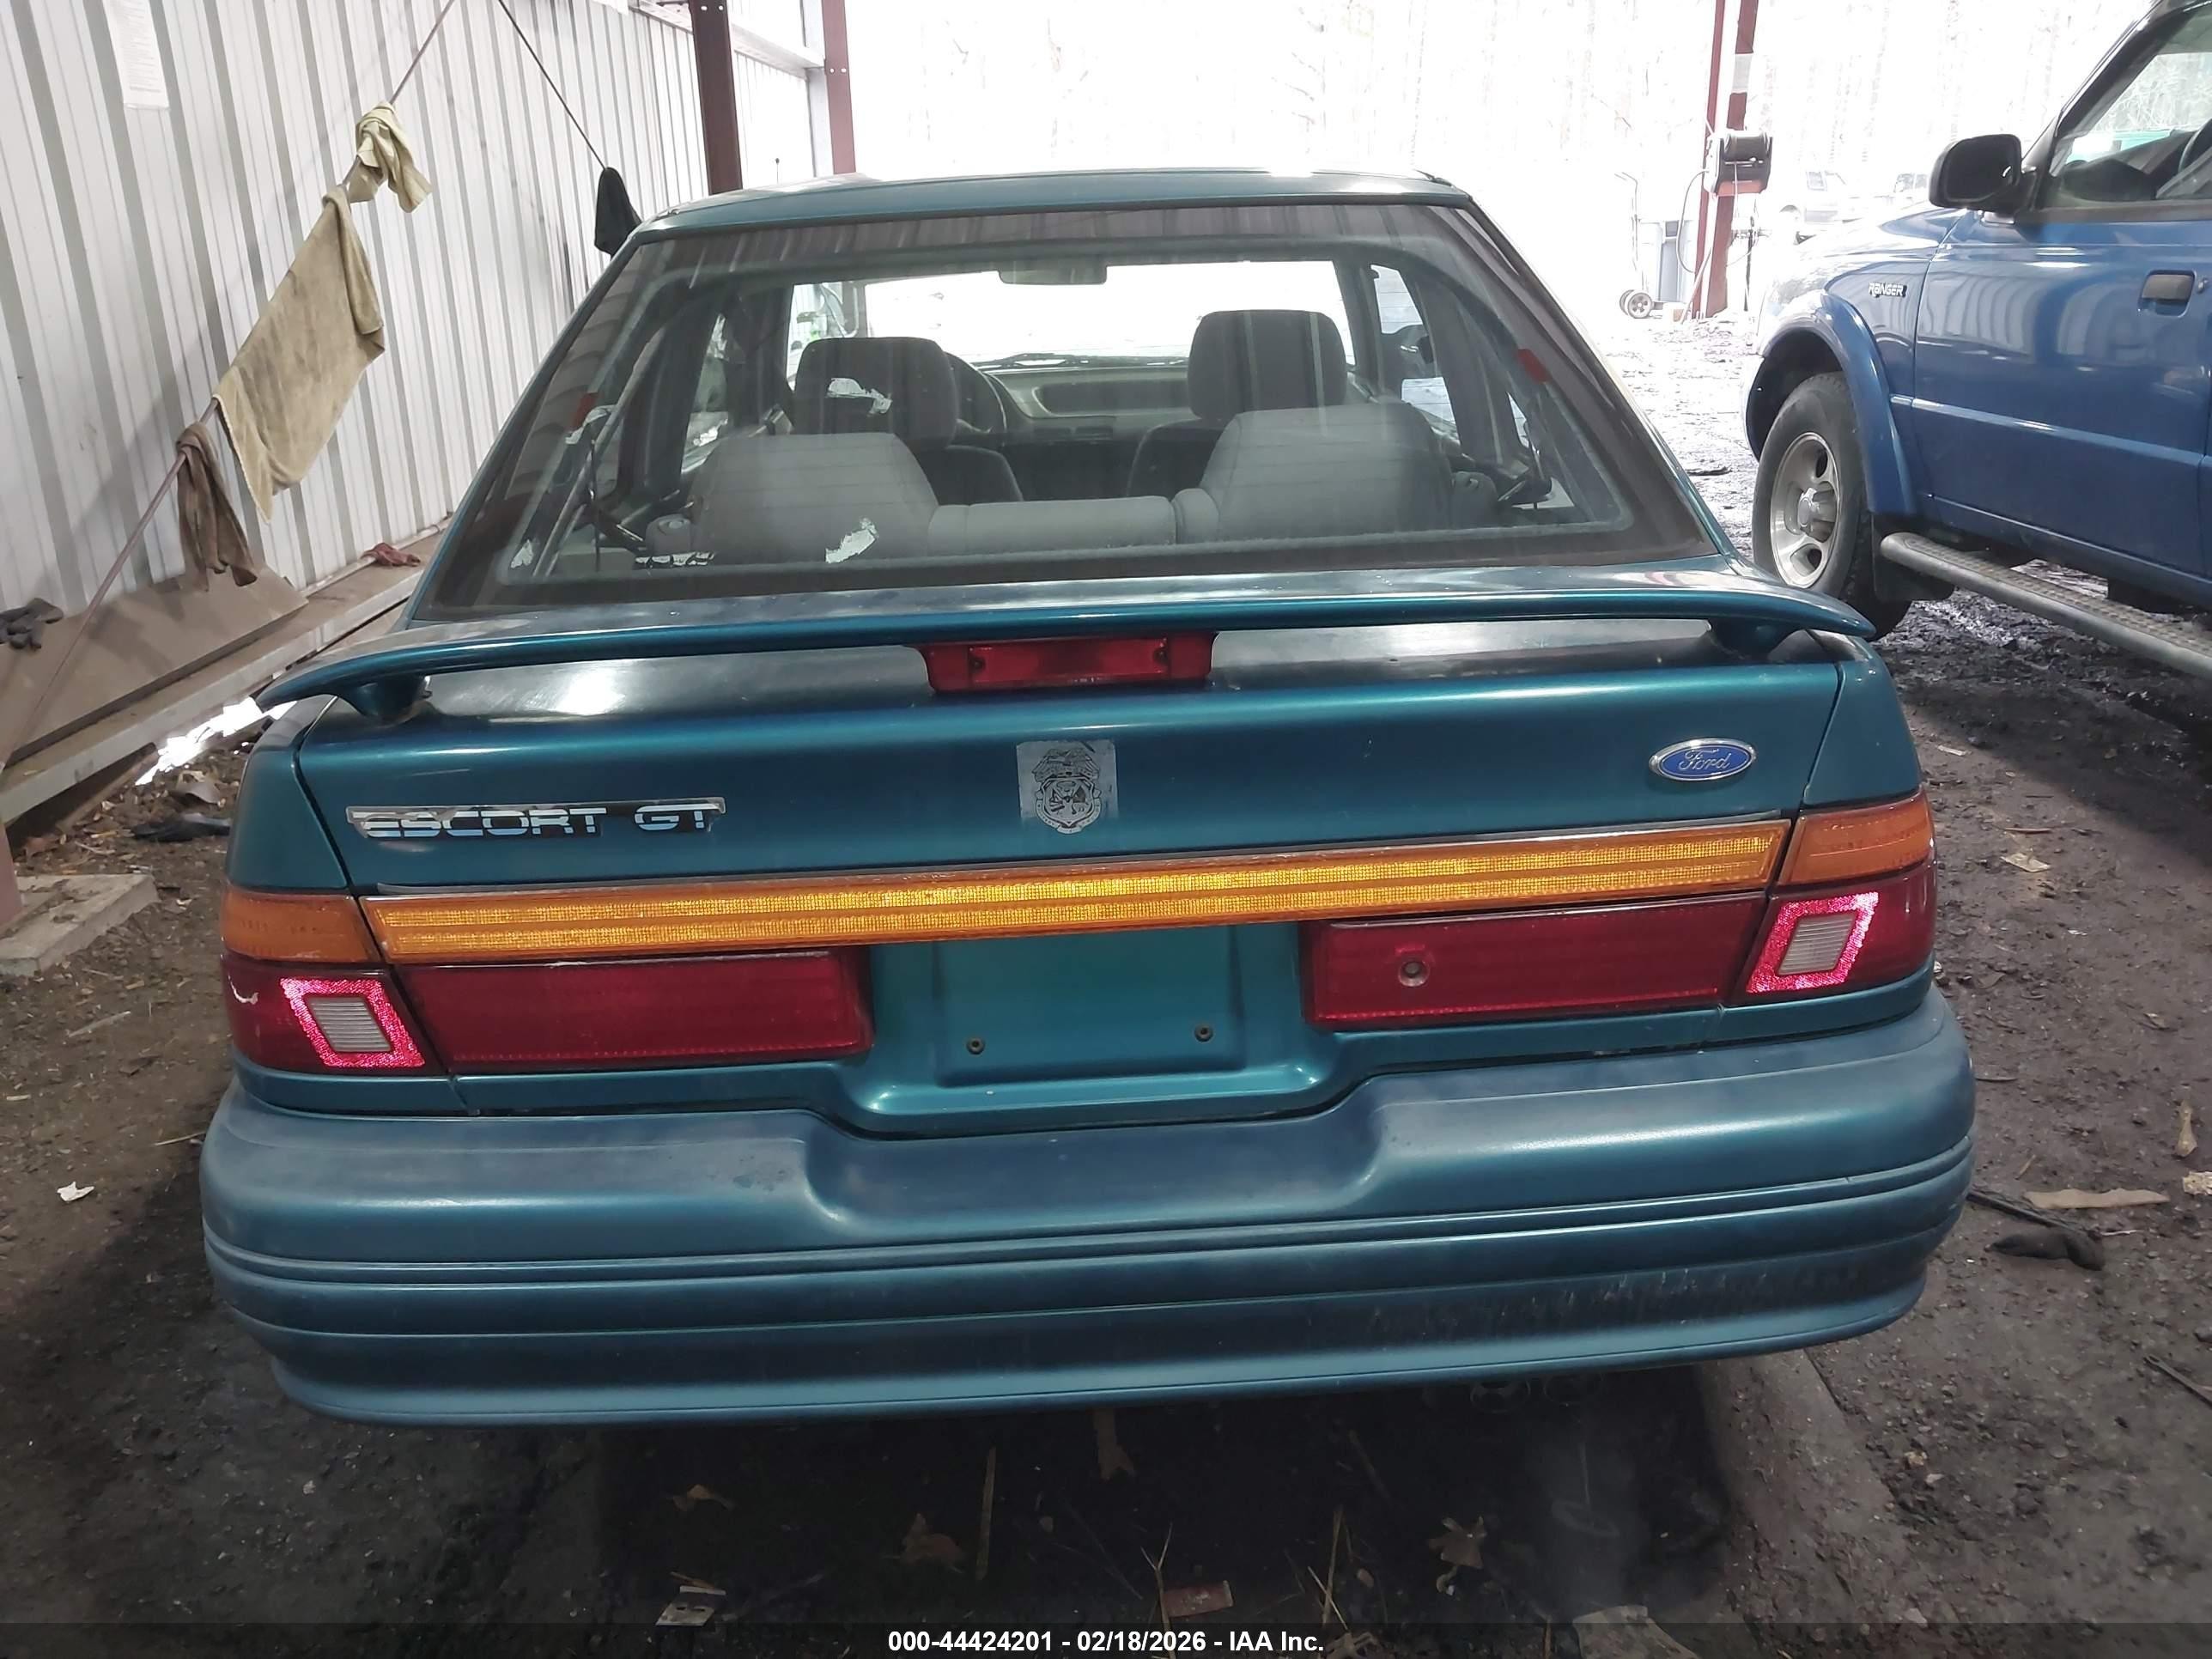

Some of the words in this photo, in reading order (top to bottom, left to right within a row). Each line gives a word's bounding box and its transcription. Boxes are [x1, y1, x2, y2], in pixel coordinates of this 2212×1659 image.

[1678, 748, 1733, 771] Ford
[350, 805, 607, 839] ESCORT
[633, 800, 724, 833] GT
